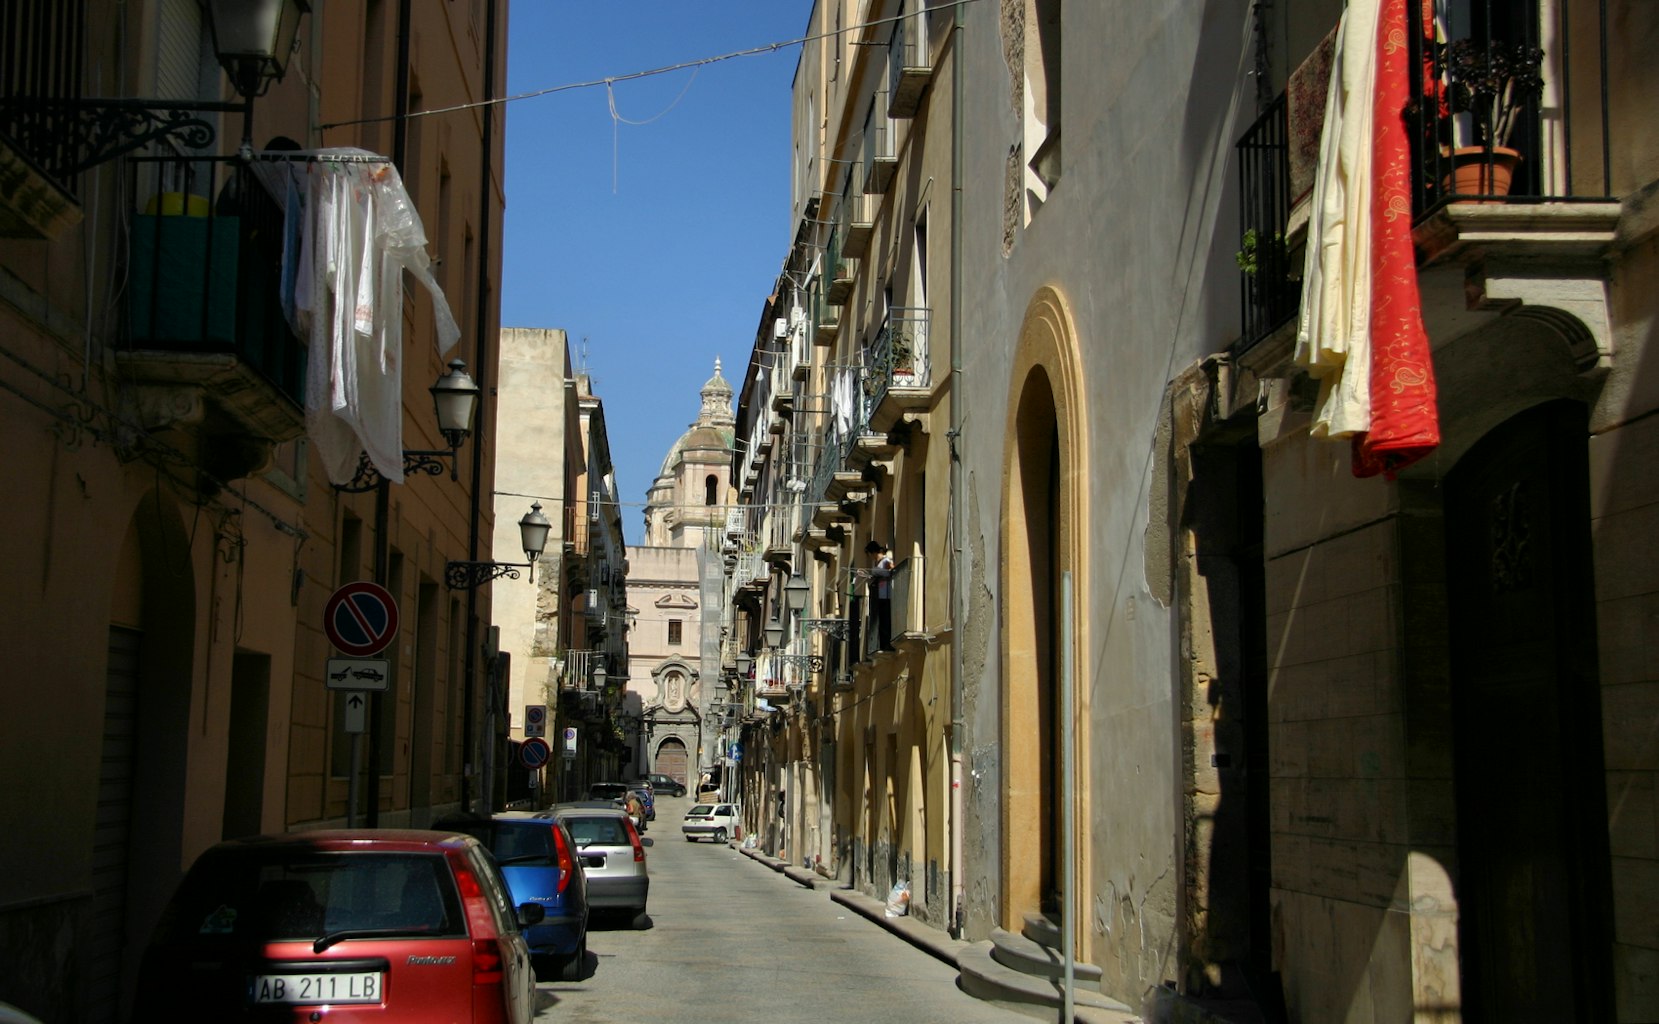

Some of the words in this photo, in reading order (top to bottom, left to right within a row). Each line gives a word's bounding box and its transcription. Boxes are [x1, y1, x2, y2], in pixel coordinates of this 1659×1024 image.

[260, 978, 285, 1000] AB
[300, 976, 336, 999] 211
[350, 975, 375, 998] LB
